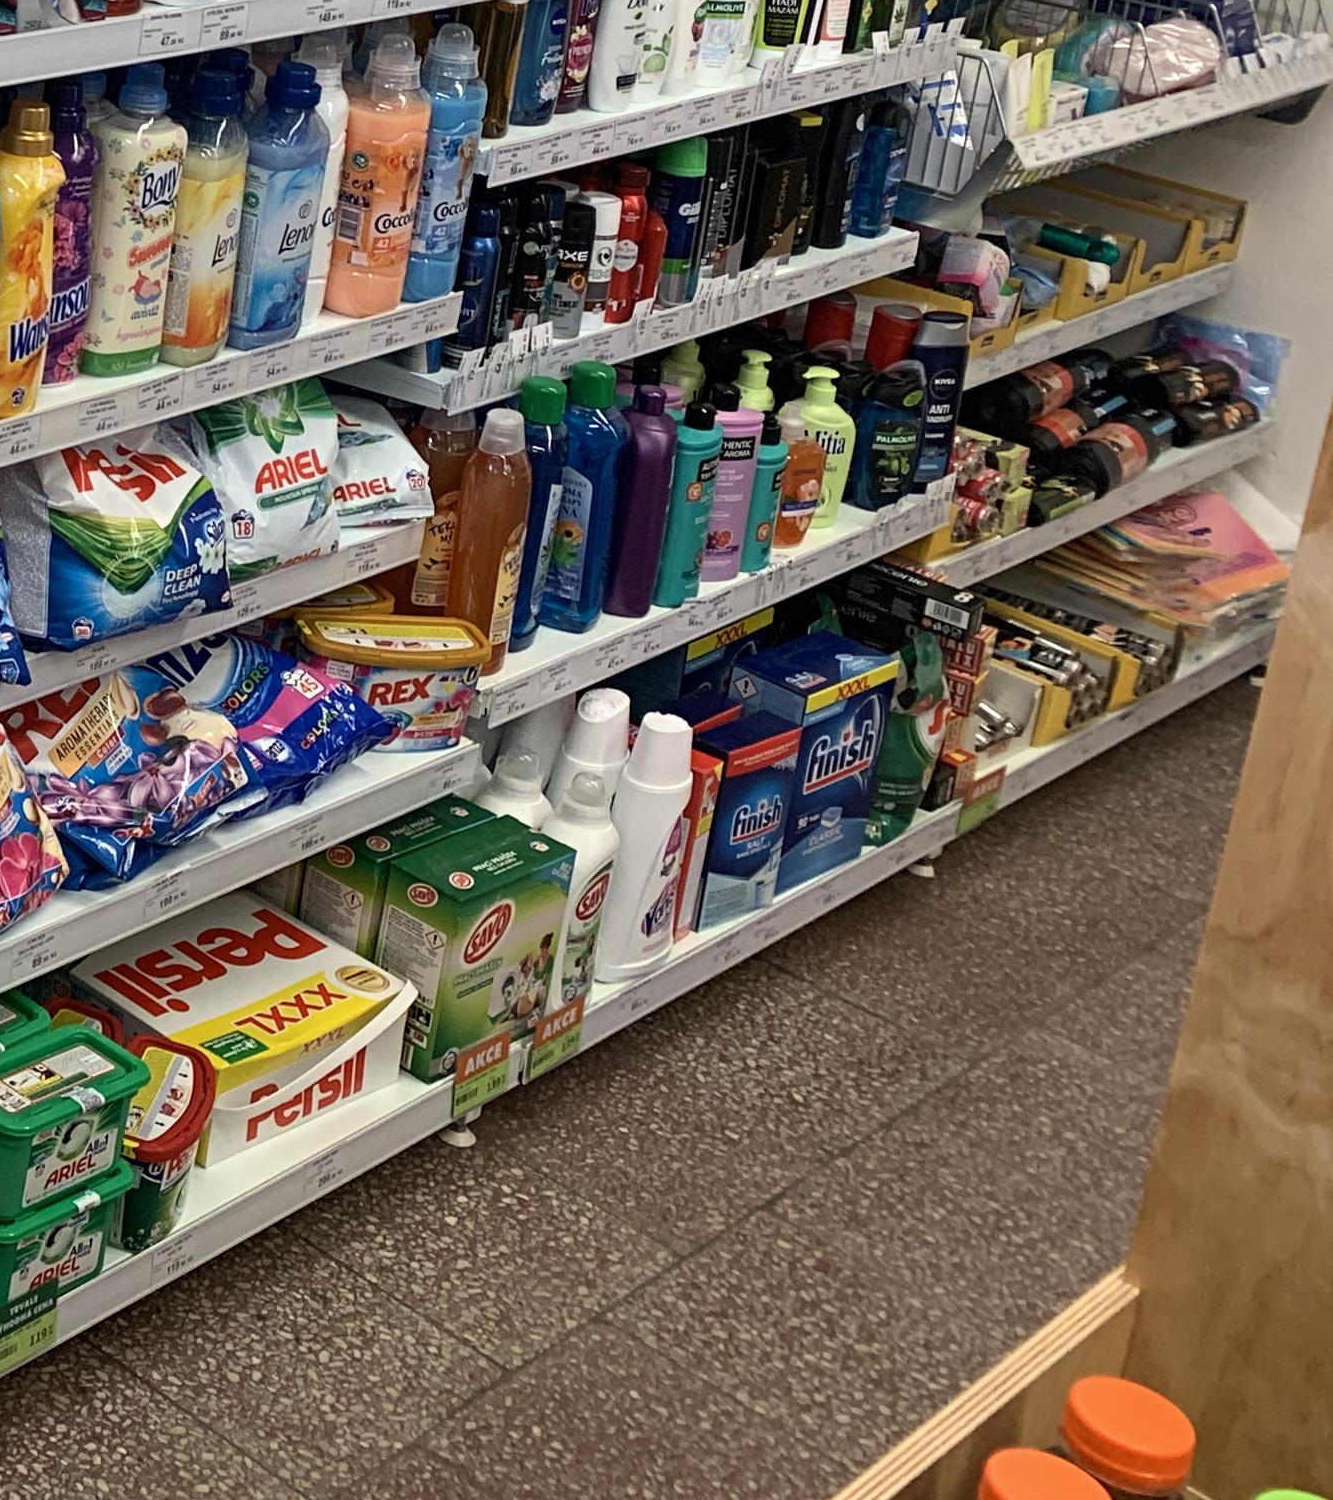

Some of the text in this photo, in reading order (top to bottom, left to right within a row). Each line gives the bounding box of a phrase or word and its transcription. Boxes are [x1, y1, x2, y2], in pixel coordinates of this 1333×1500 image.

[254, 449, 328, 494] ARIEL
[368, 675, 434, 705] REX
[804, 724, 874, 783] finish
[732, 800, 781, 837] finish
[95, 909, 331, 1015] Persil
[239, 982, 348, 1034] XXXL
